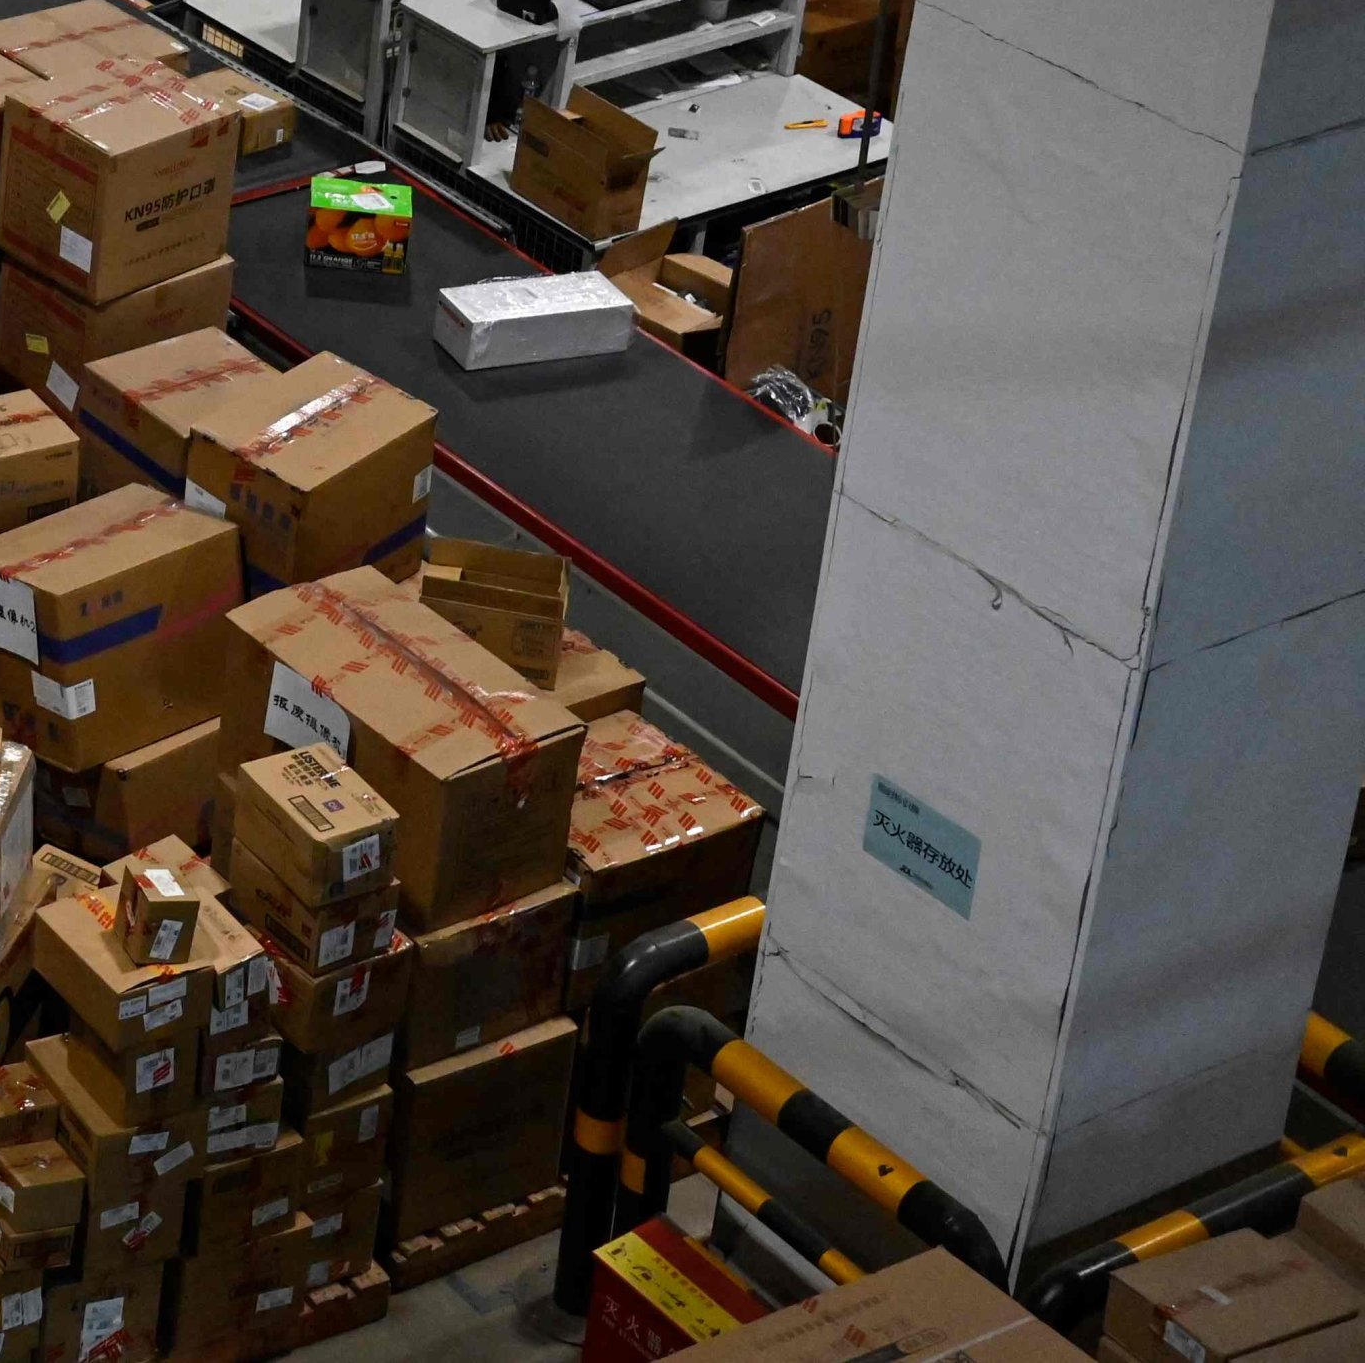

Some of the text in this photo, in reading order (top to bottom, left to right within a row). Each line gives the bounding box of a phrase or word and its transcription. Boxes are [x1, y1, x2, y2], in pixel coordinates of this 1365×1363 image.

[124, 175, 216, 223] KN95防护口罩
[872, 809, 973, 890] 灭火器存放处
